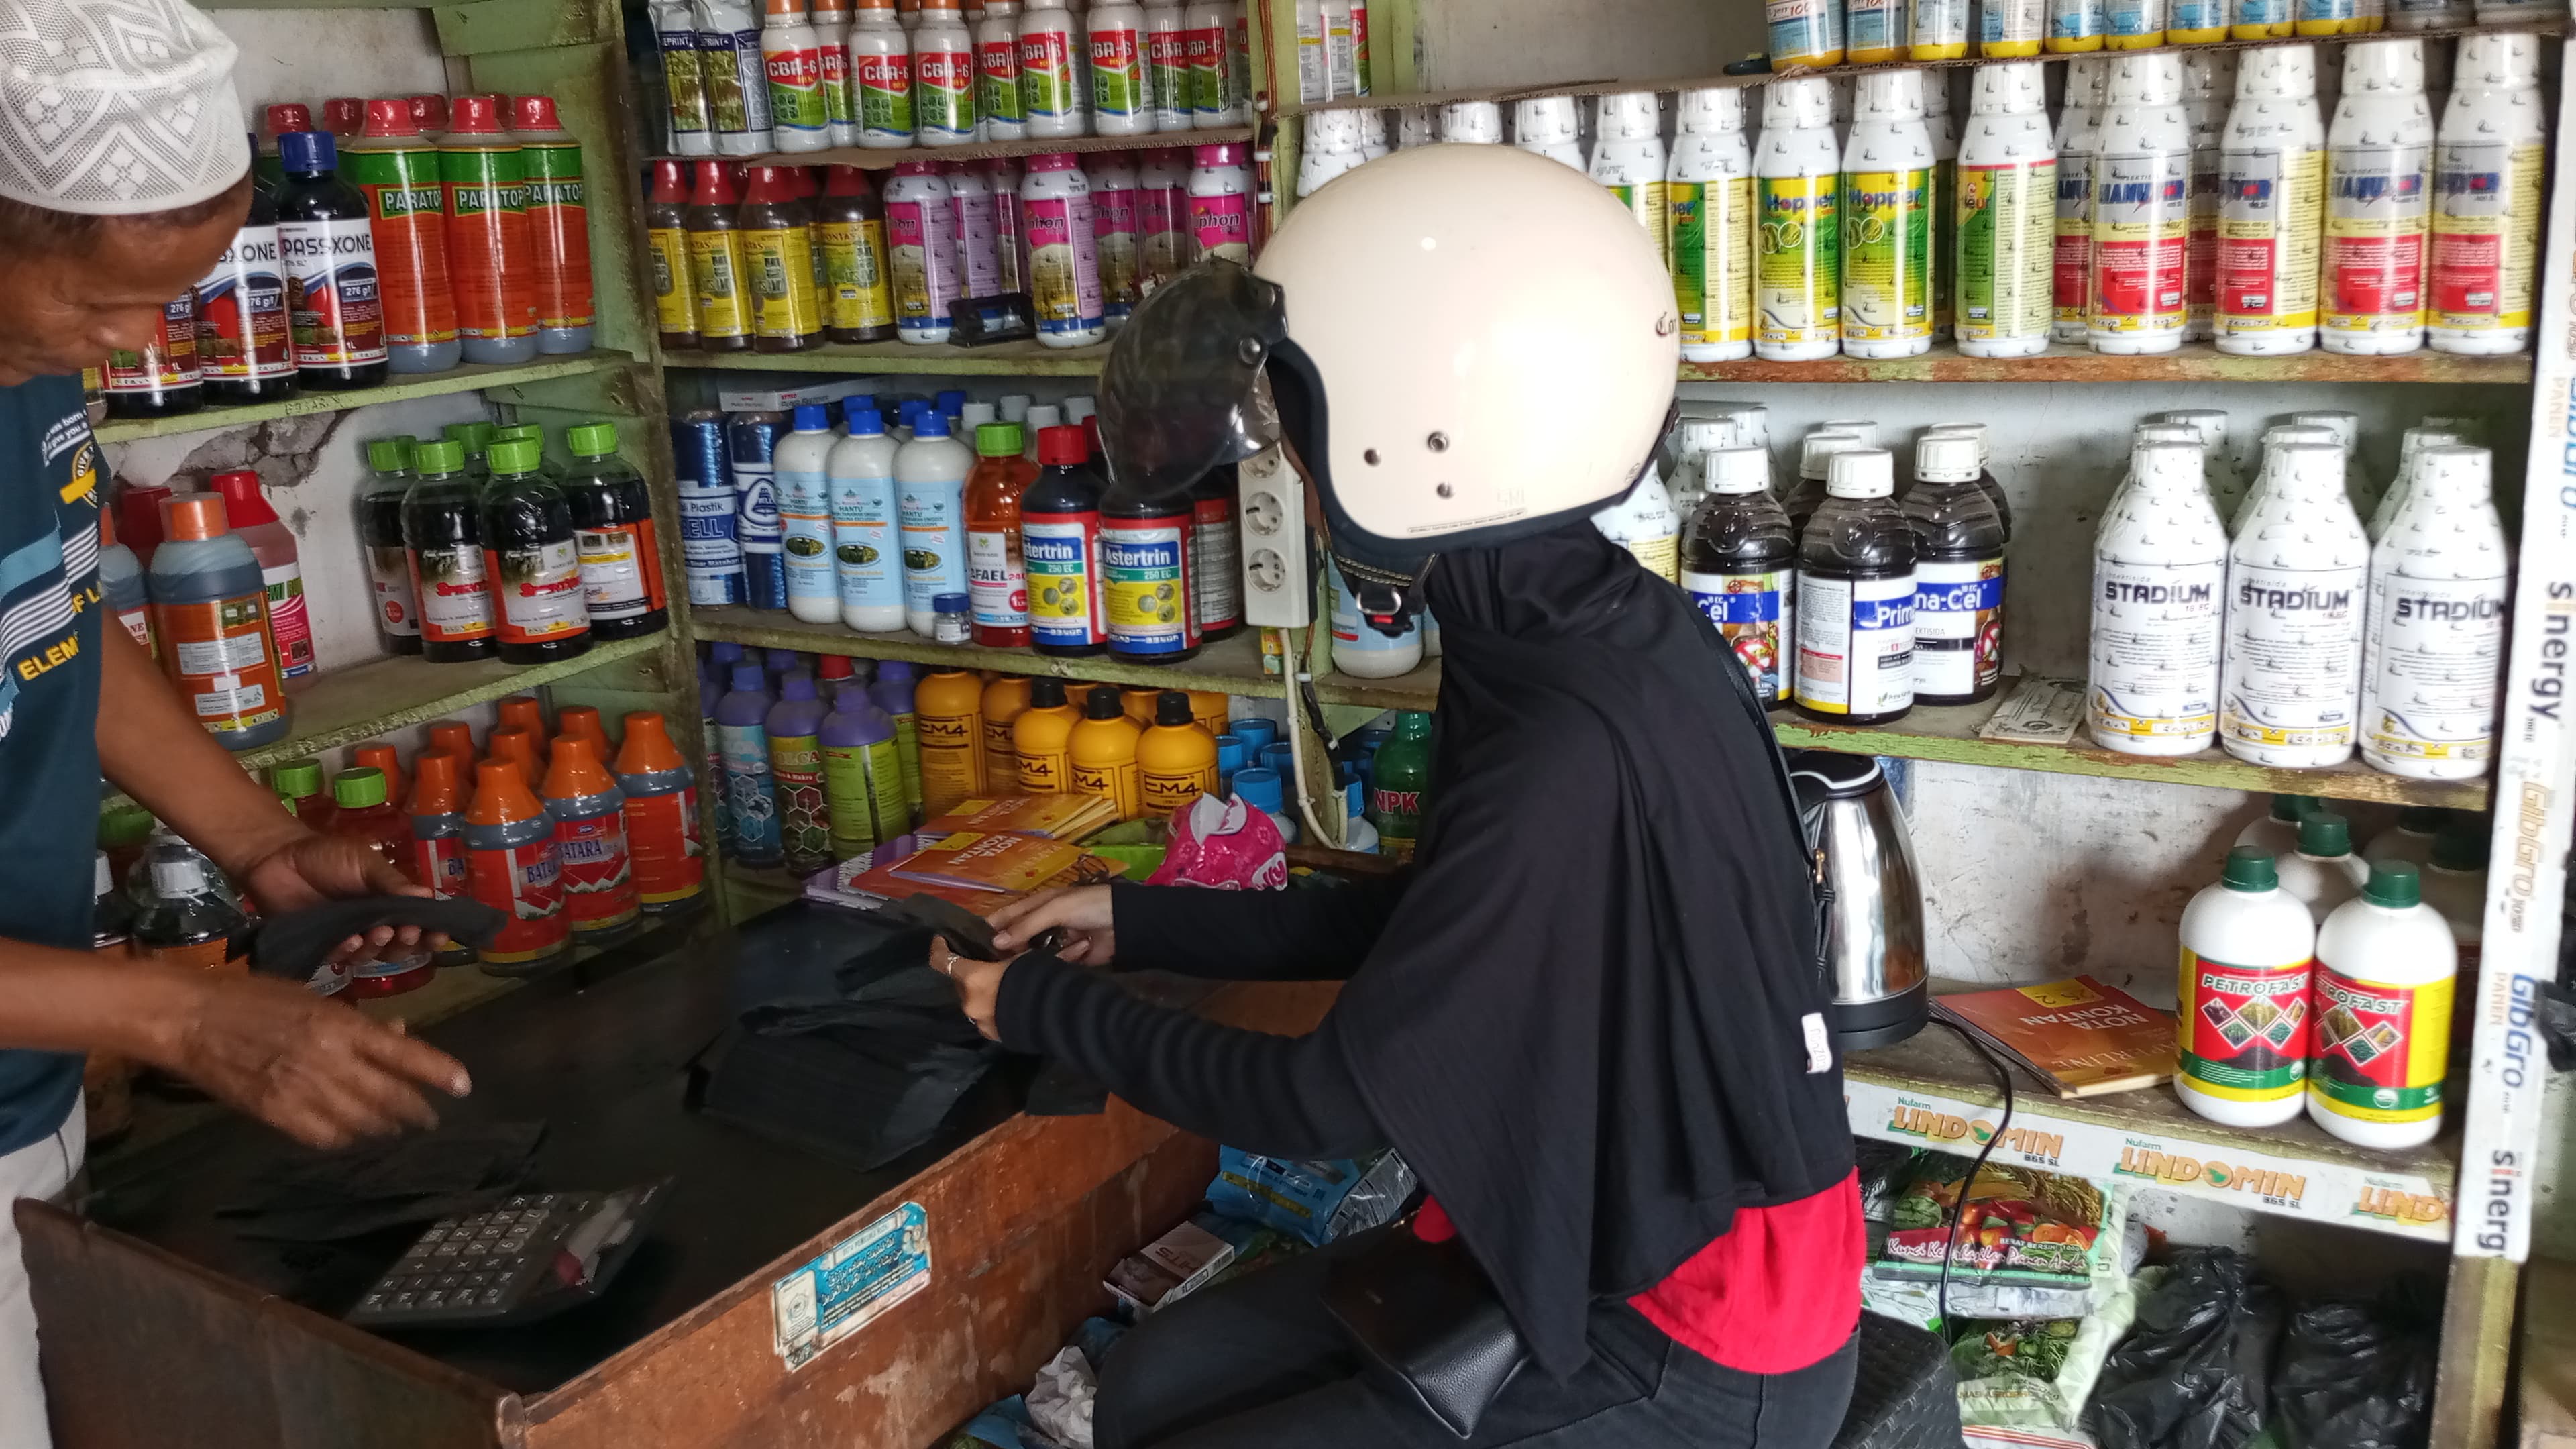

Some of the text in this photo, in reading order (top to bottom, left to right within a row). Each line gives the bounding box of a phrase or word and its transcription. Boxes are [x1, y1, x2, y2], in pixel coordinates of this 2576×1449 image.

[282, 233, 372, 256] PASSXONE
[1106, 548, 1171, 567] Astertrin
[1375, 788, 1422, 815] NPK
[2512, 781, 2553, 897] GibGro
[2203, 972, 2308, 998] PETROFAST
[2018, 1004, 2131, 1026] KONTAN
[2070, 1012, 2149, 1032] NOTA
[2502, 973, 2536, 1088] GibGro
[1897, 1096, 1931, 1110] Nufarm
[1892, 1106, 2065, 1159] LINDOMIN
[2125, 1137, 2162, 1152] Nufarm
[2120, 1146, 2308, 1201] LINDOMIN
[2475, 1150, 2520, 1258] sinerg
[2027, 1241, 2055, 1251] BERSIH
